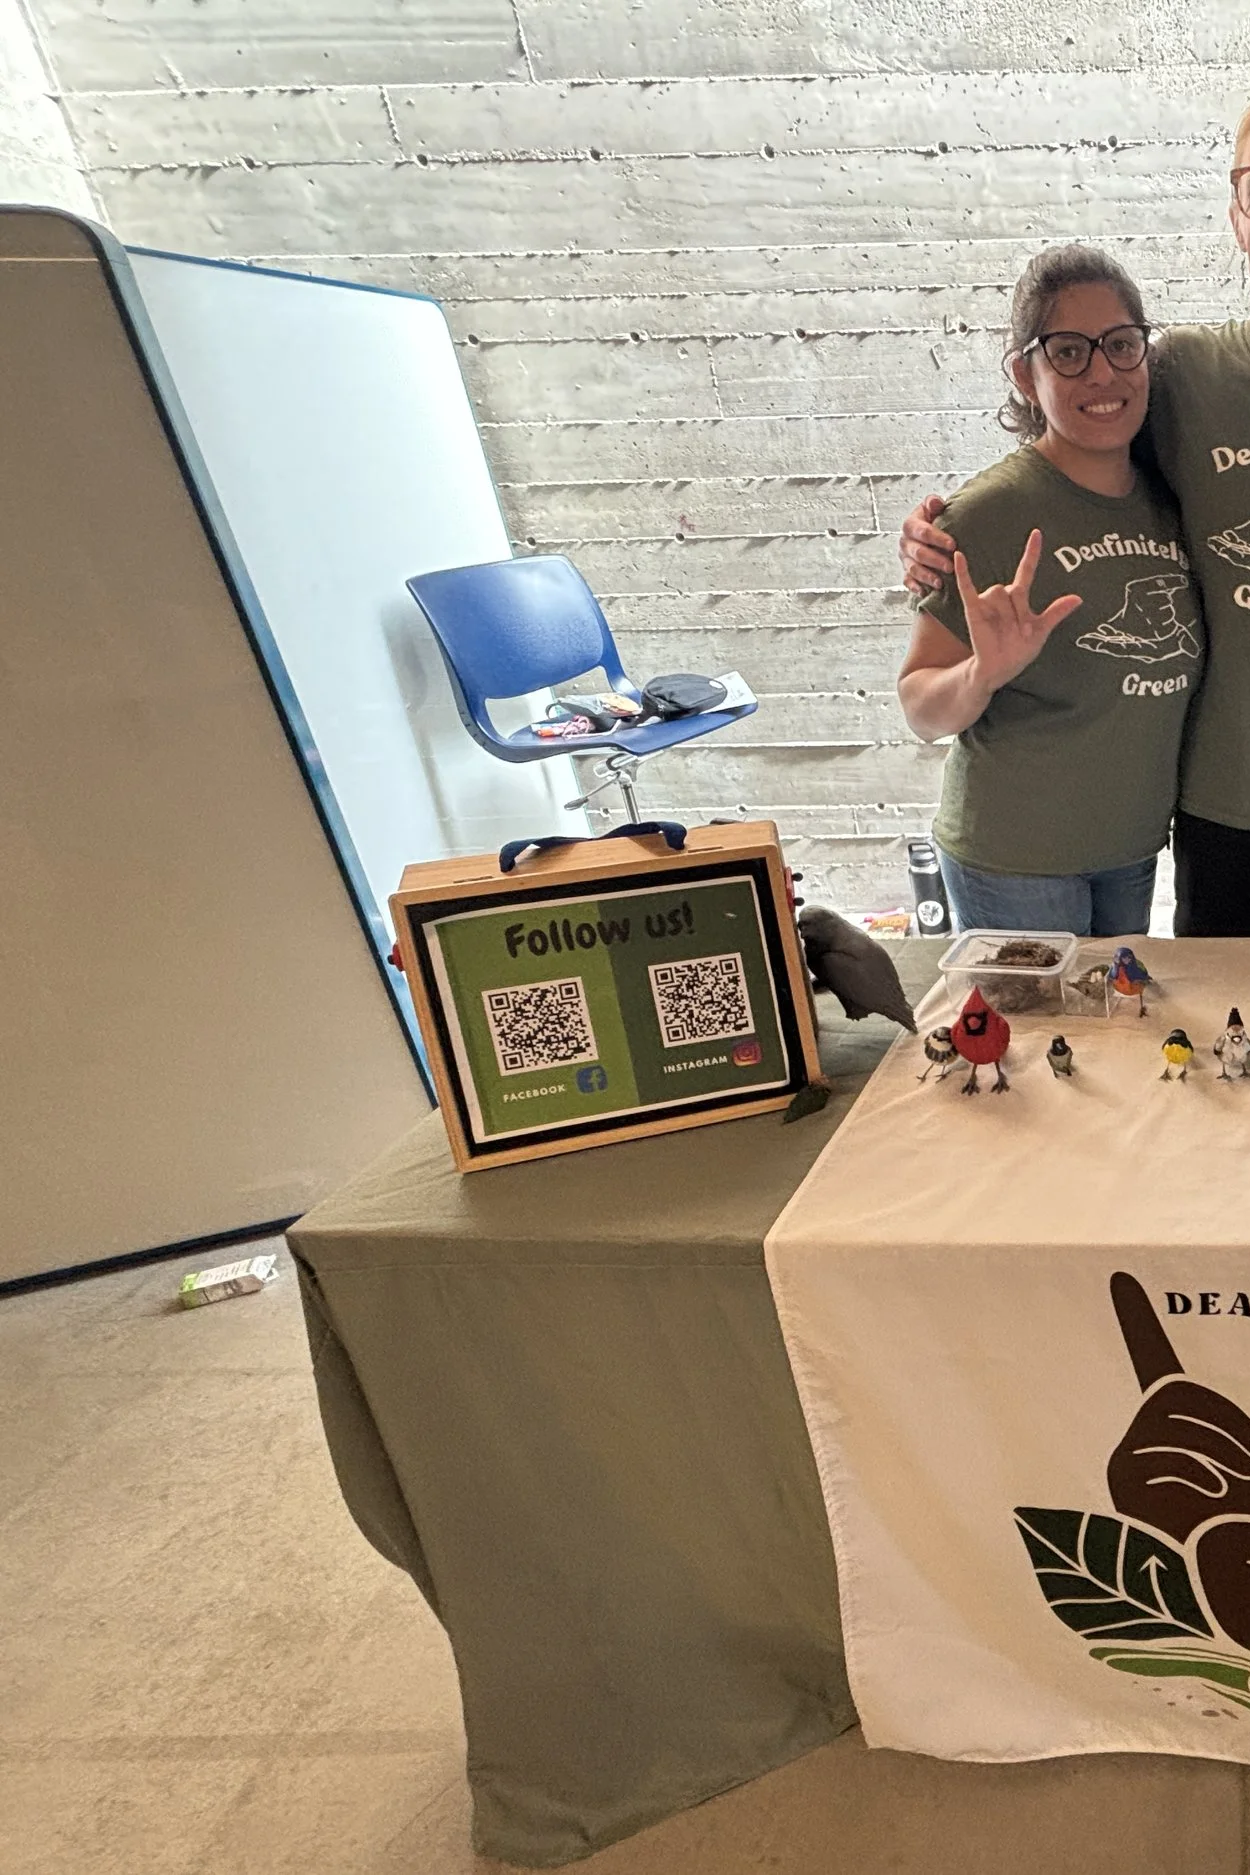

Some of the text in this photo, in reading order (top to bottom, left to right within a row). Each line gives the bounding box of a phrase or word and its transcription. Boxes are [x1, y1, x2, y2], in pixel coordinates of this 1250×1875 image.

[1053, 533, 1190, 573] Deafinitely
[1122, 673, 1189, 697] Green
[504, 902, 697, 959] Follow us!
[663, 1055, 728, 1075] INSTAGRAM
[503, 1083, 566, 1103] FACEBOOK
